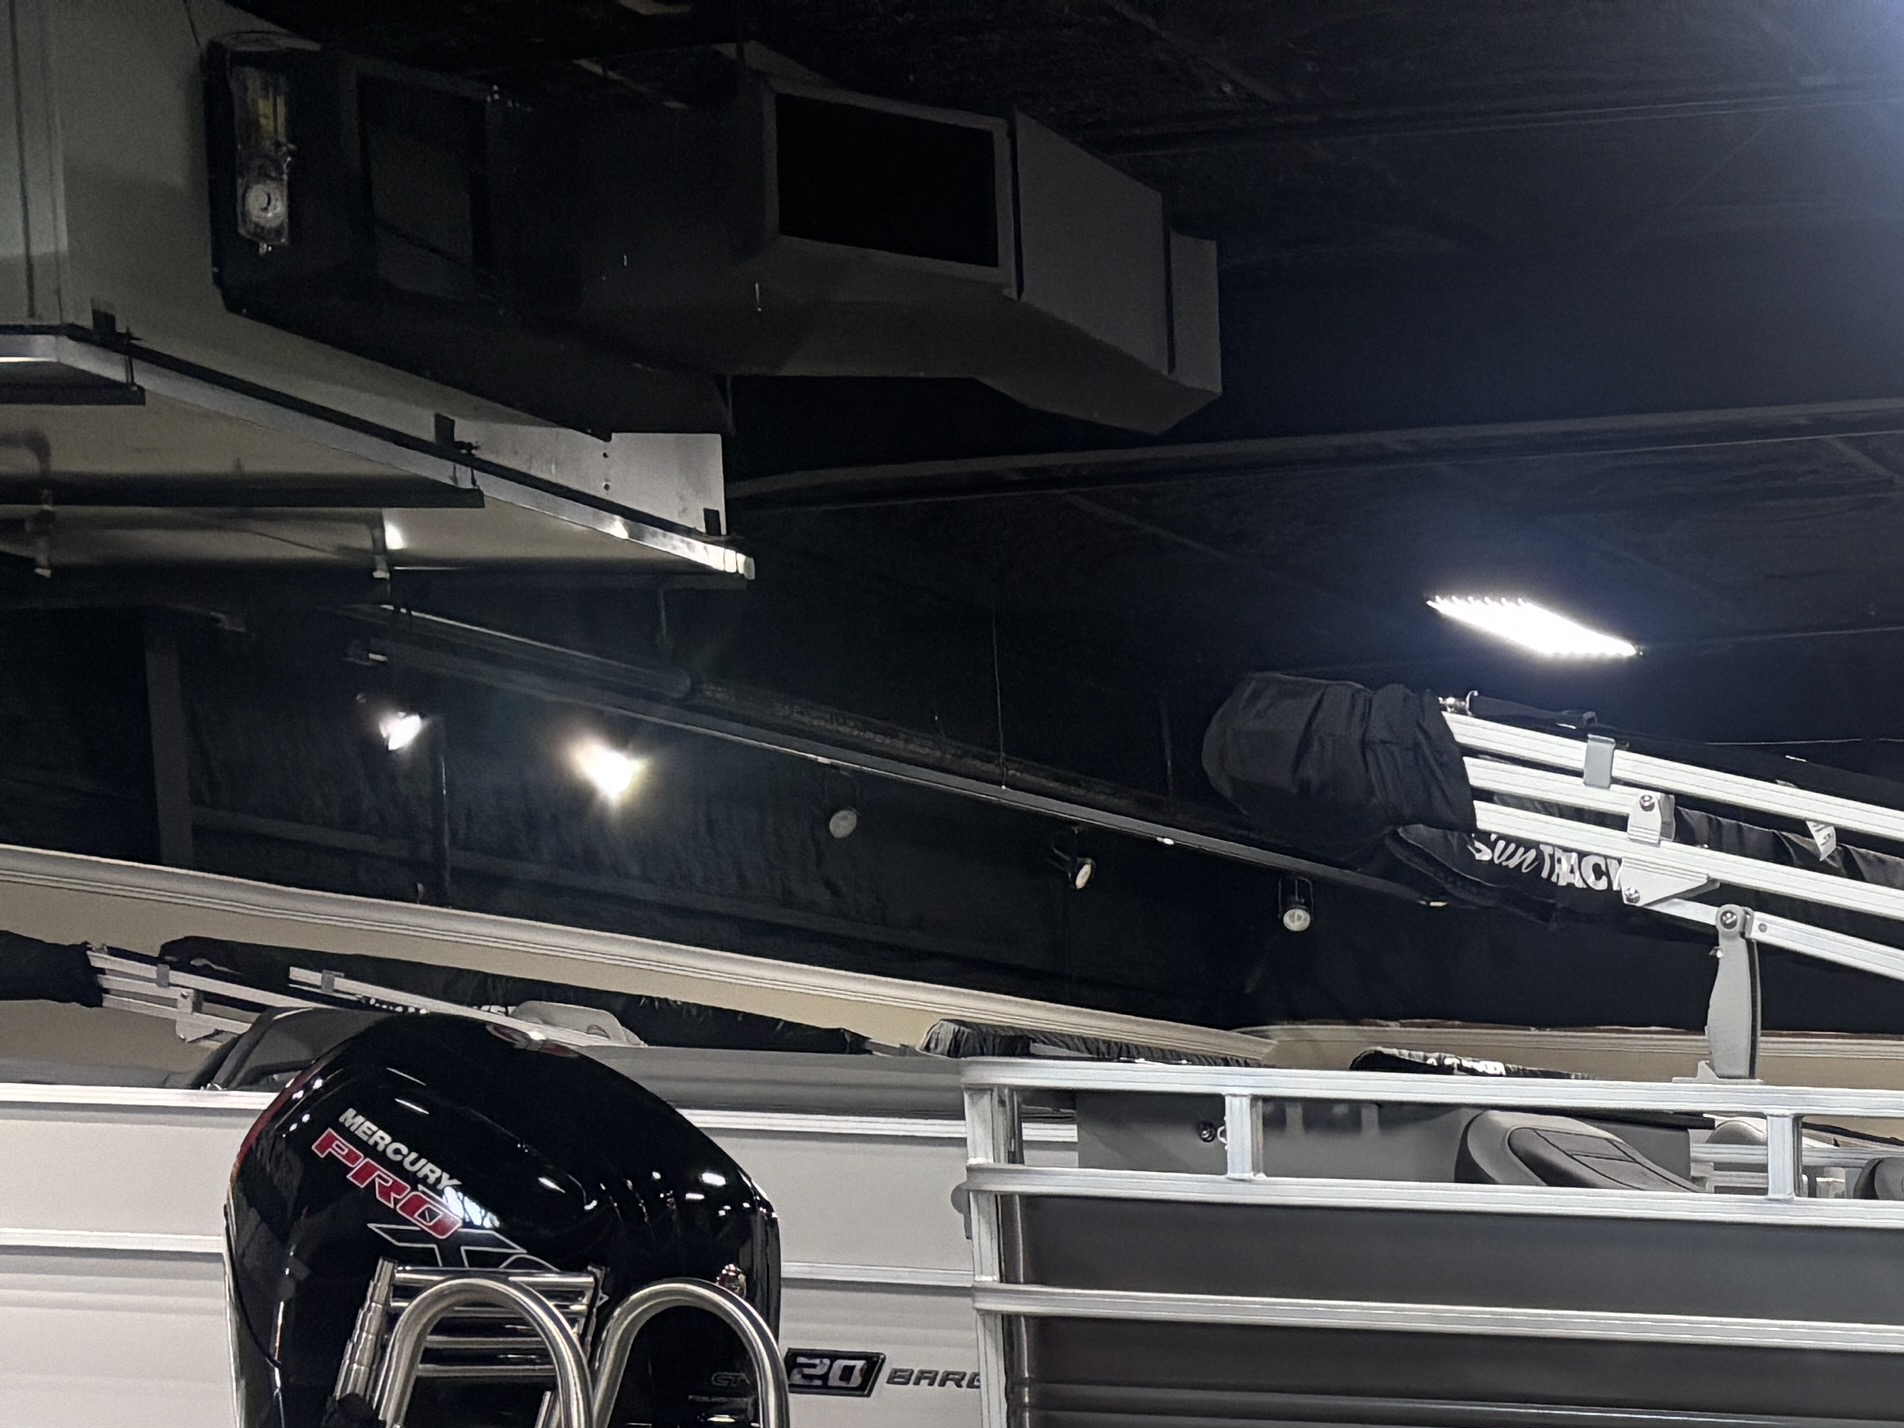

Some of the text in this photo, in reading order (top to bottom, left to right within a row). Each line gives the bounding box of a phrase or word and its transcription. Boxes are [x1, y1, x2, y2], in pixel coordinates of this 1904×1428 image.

[311, 1127, 463, 1239] PRO
[338, 1107, 462, 1191] MERCURY
[789, 1356, 868, 1388] 20
